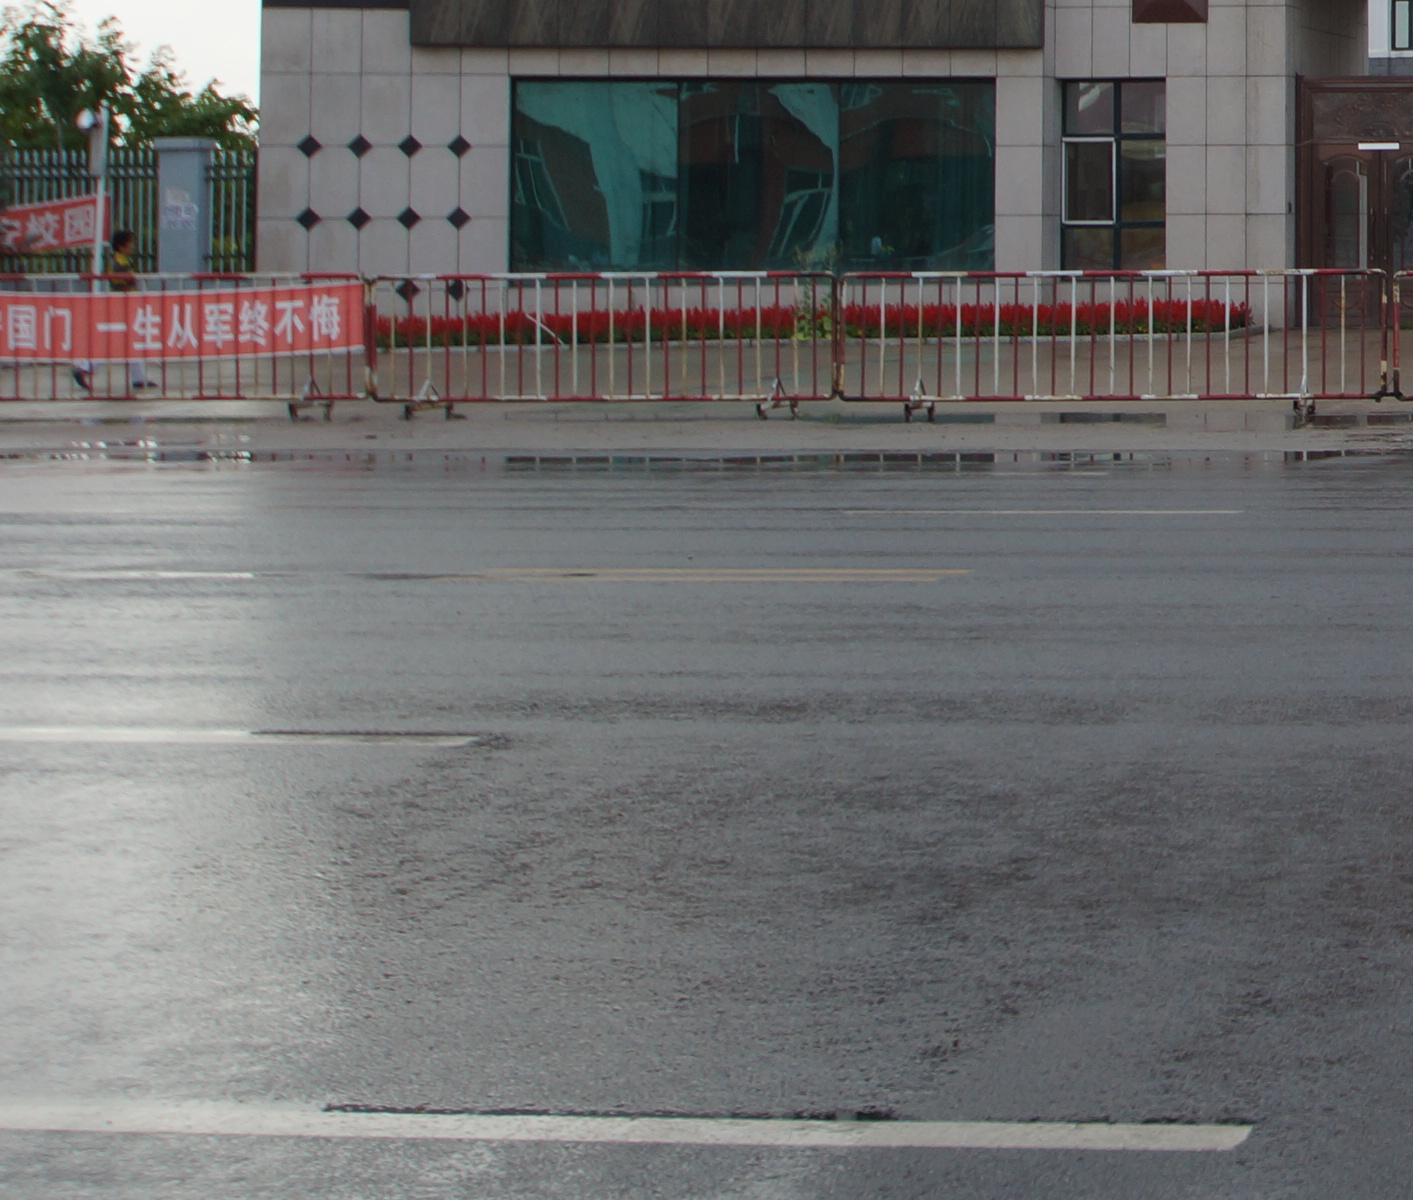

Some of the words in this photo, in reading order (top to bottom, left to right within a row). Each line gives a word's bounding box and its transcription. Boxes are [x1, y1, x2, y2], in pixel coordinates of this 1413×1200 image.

[0, 304, 72, 351] 国门
[96, 294, 341, 351] 一生从军终不悔
